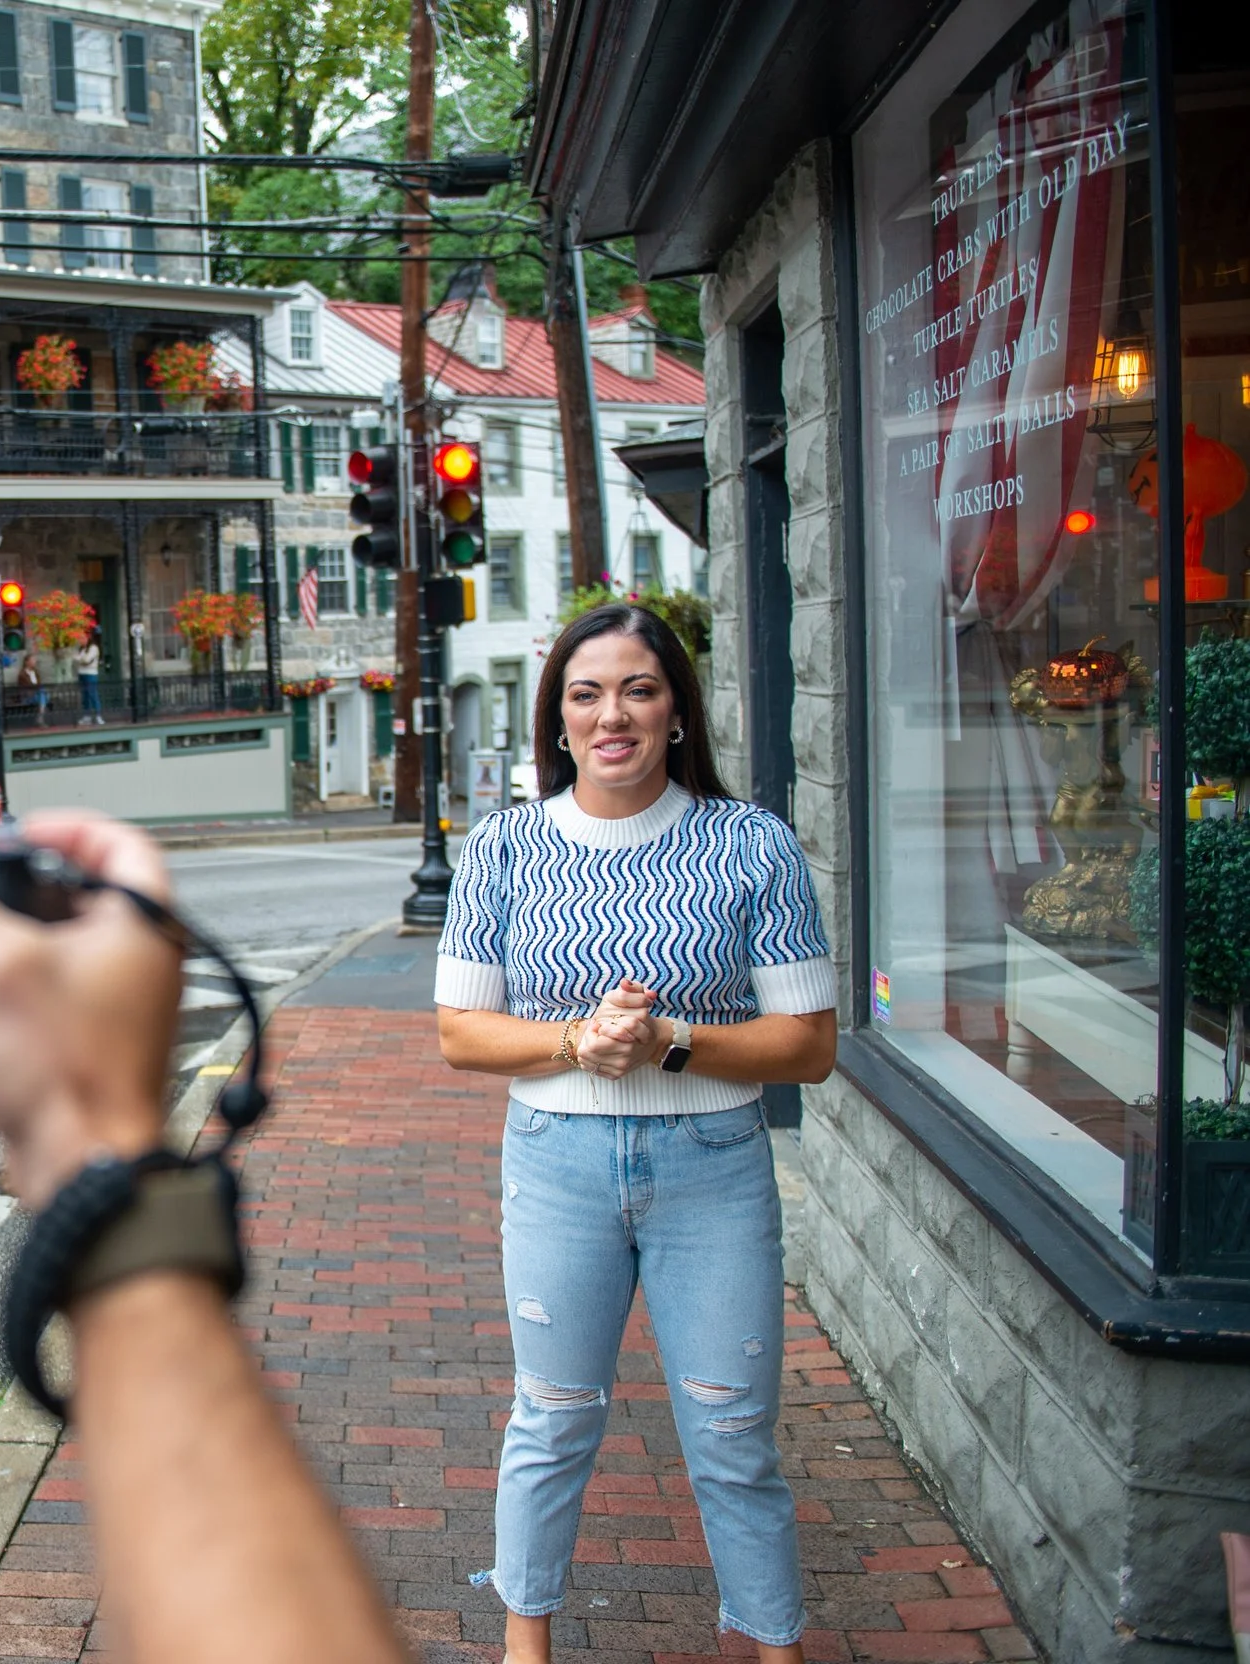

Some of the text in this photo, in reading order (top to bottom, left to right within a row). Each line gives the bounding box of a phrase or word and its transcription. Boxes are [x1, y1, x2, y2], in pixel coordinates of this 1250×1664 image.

[866, 112, 1130, 334] CHOCOLATE CRABS WITH OLD BAY
[931, 142, 1003, 226] TRUFFLES
[913, 256, 1038, 358] TURTLE TURTLES
[907, 319, 1058, 418] SEA SALT CARAMELS
[900, 384, 1076, 477] A PAIR OF SALTY BALLS
[933, 474, 1024, 523] WORKSHOPS
